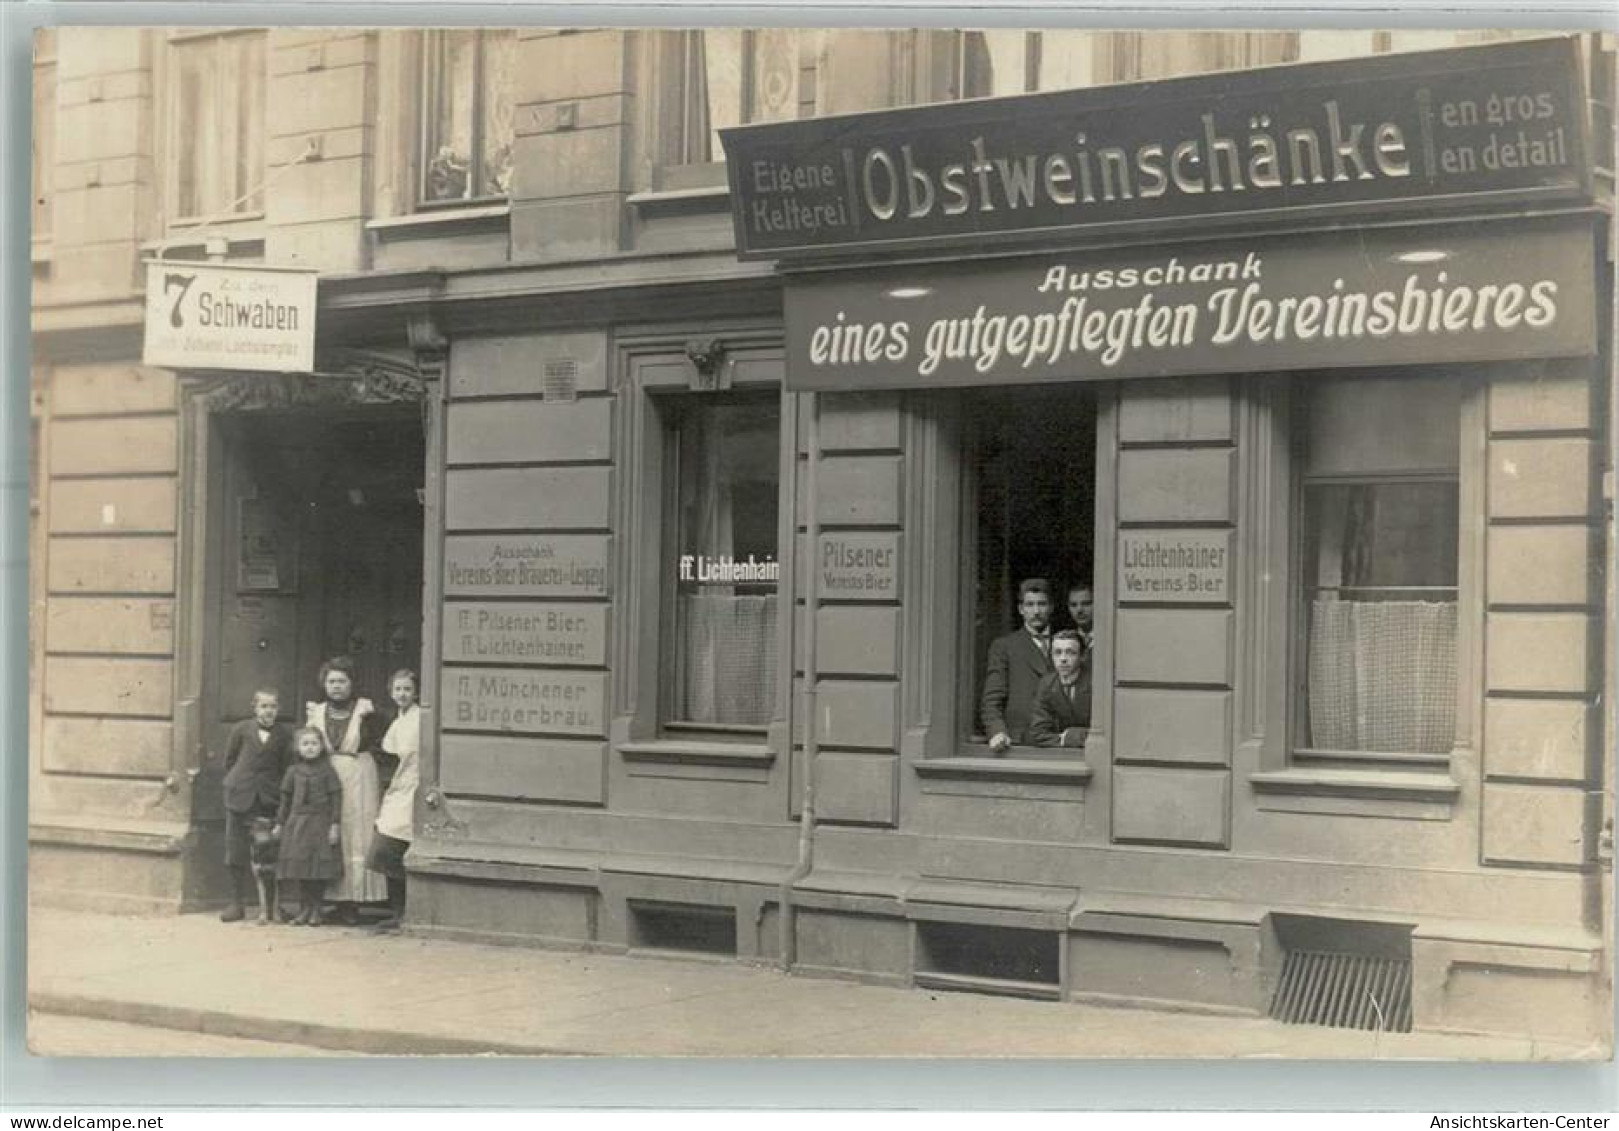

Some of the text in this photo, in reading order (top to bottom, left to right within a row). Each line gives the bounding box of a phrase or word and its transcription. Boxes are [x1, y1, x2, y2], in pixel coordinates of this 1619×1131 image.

[1441, 91, 1555, 128] en gros
[862, 100, 1411, 219] Obstweinschänke
[1441, 128, 1568, 174] en detail
[752, 160, 836, 193] Eigene
[752, 195, 847, 232] Kelterei
[1037, 251, 1263, 292] Ausschank
[164, 272, 299, 331] 7 Schwaben
[809, 271, 1559, 375] eines gutgepflegten Vereinsbieres
[823, 541, 893, 568] Pilsener
[1124, 539, 1225, 568] Lichtenhainer
[478, 677, 586, 701] Münchener
